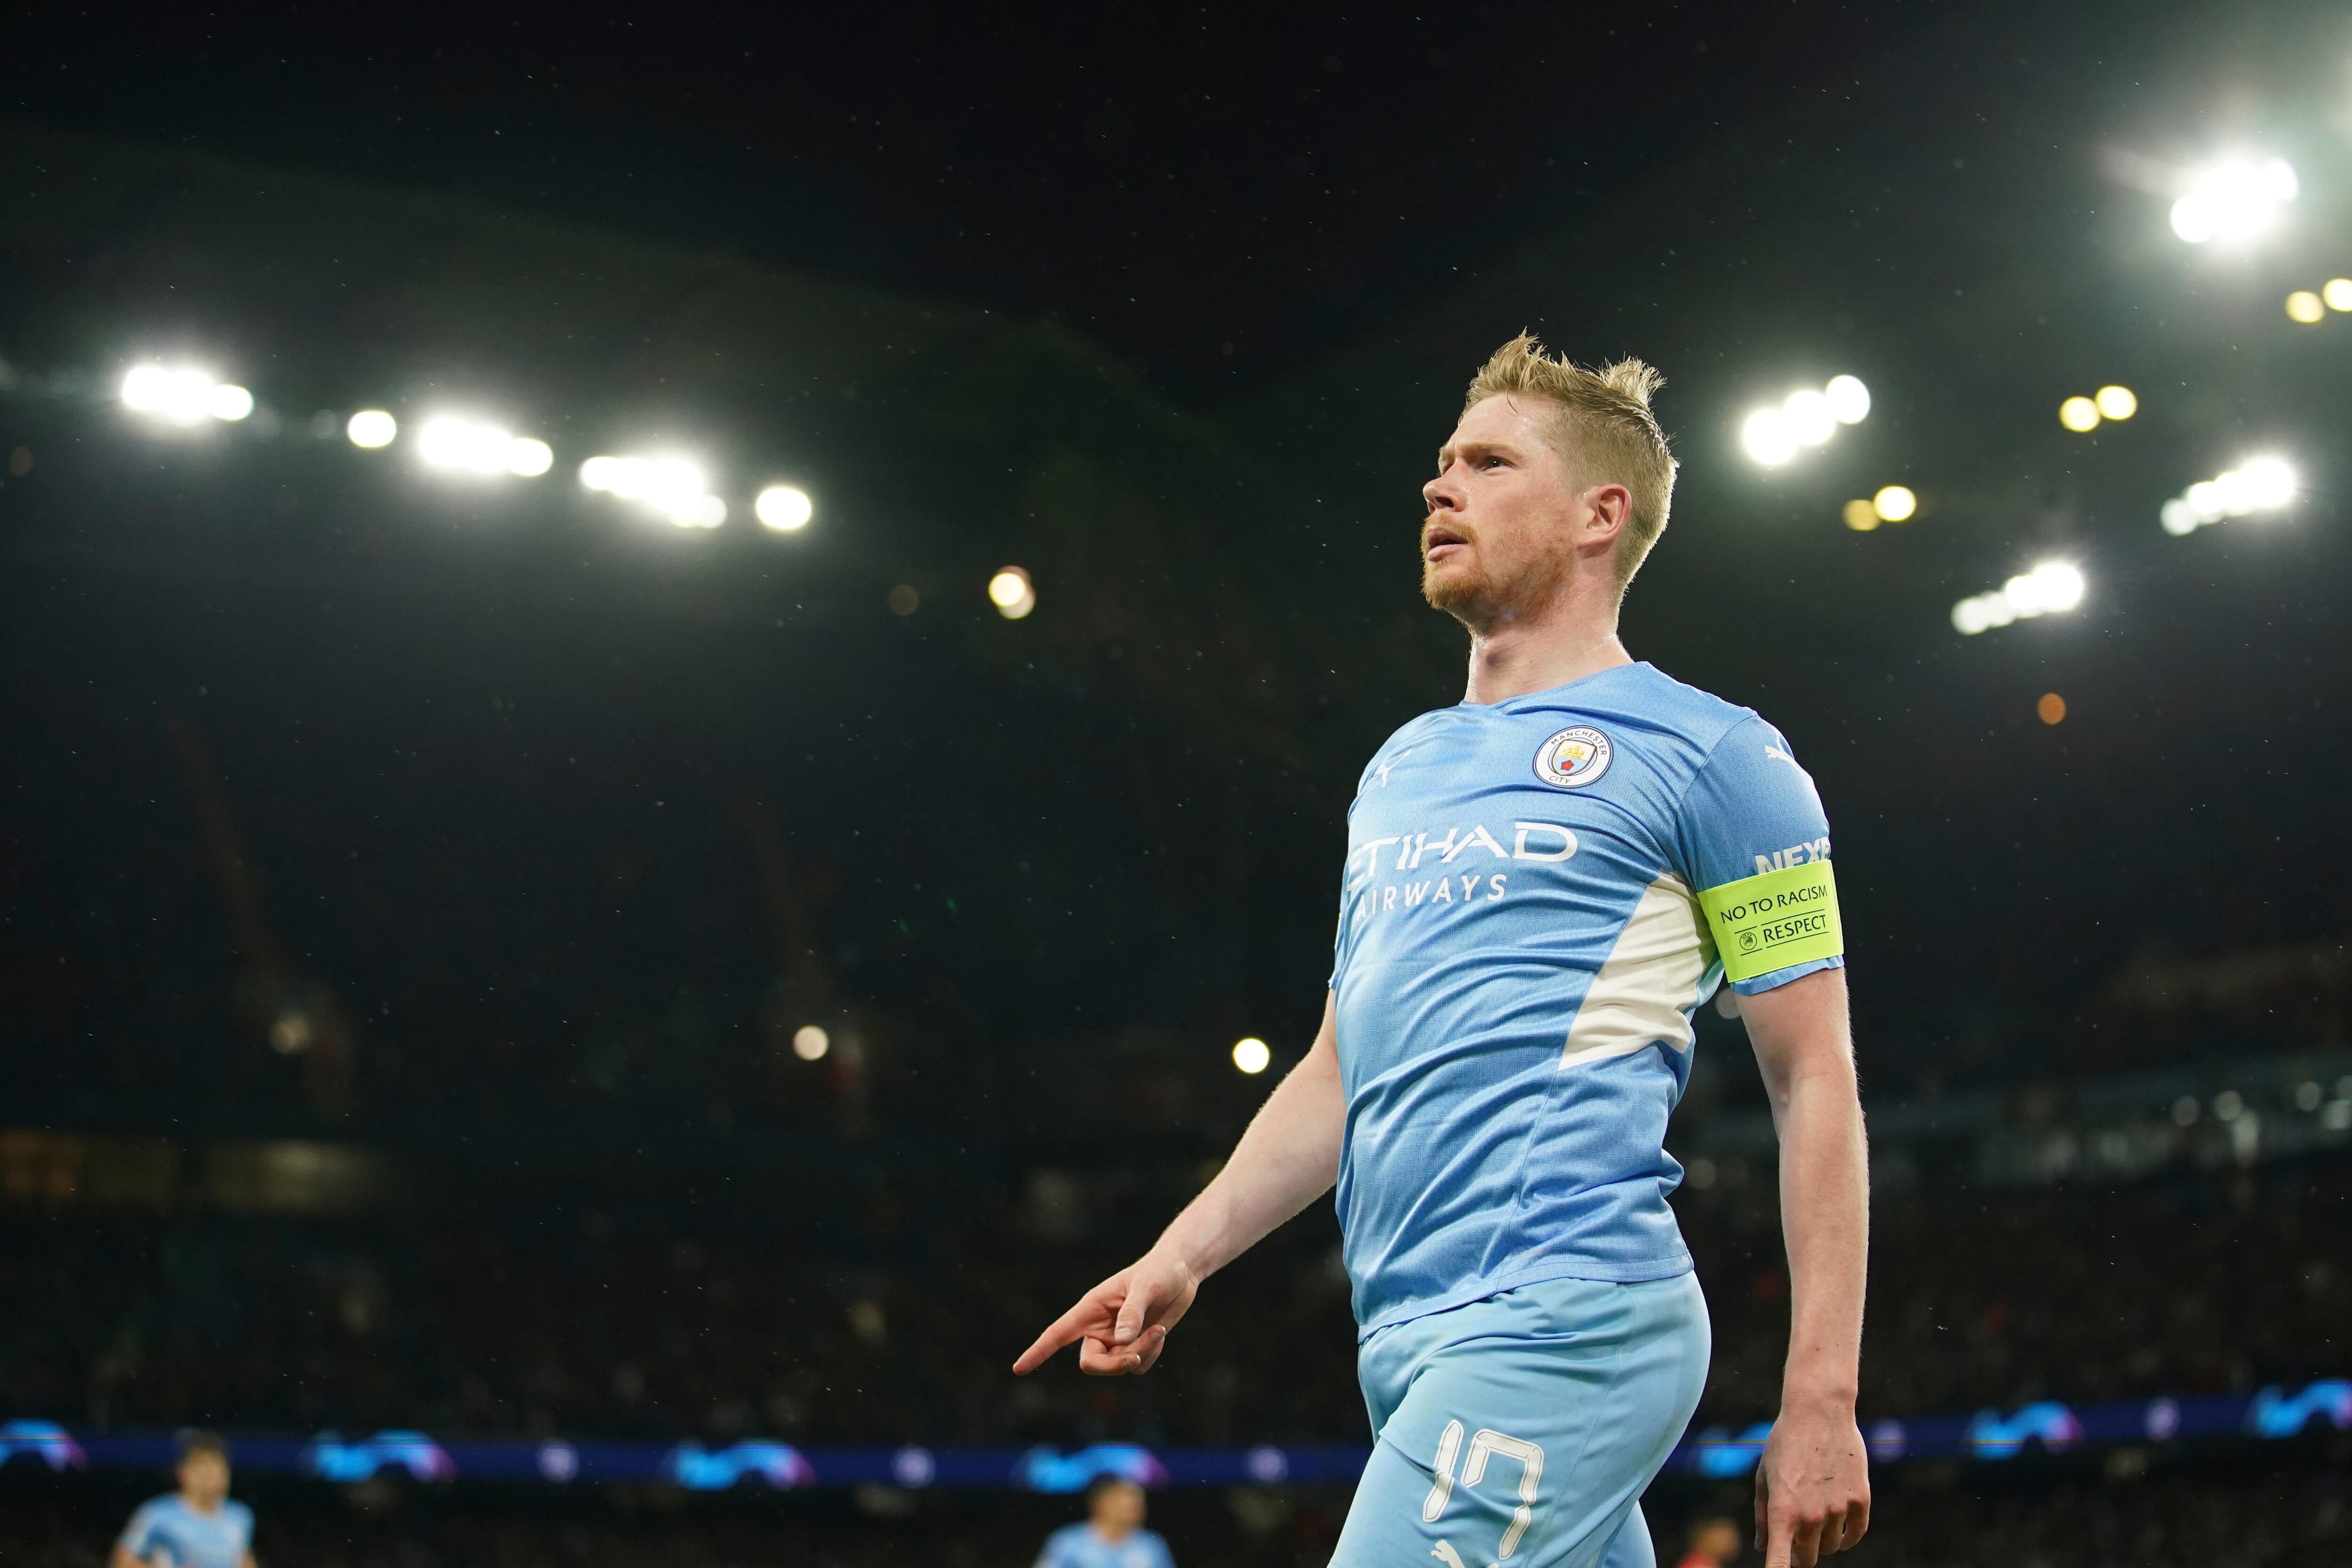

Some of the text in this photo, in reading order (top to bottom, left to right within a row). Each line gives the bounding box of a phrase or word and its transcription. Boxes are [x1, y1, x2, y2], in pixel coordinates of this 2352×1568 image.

[1551, 730, 1607, 755] MANCHESTER
[1356, 874, 1507, 921] AIRWAYS
[1721, 885, 1828, 923] NO TO RACISM
[1763, 915, 1826, 942] RESPECT
[1423, 1420, 1544, 1560] 17
